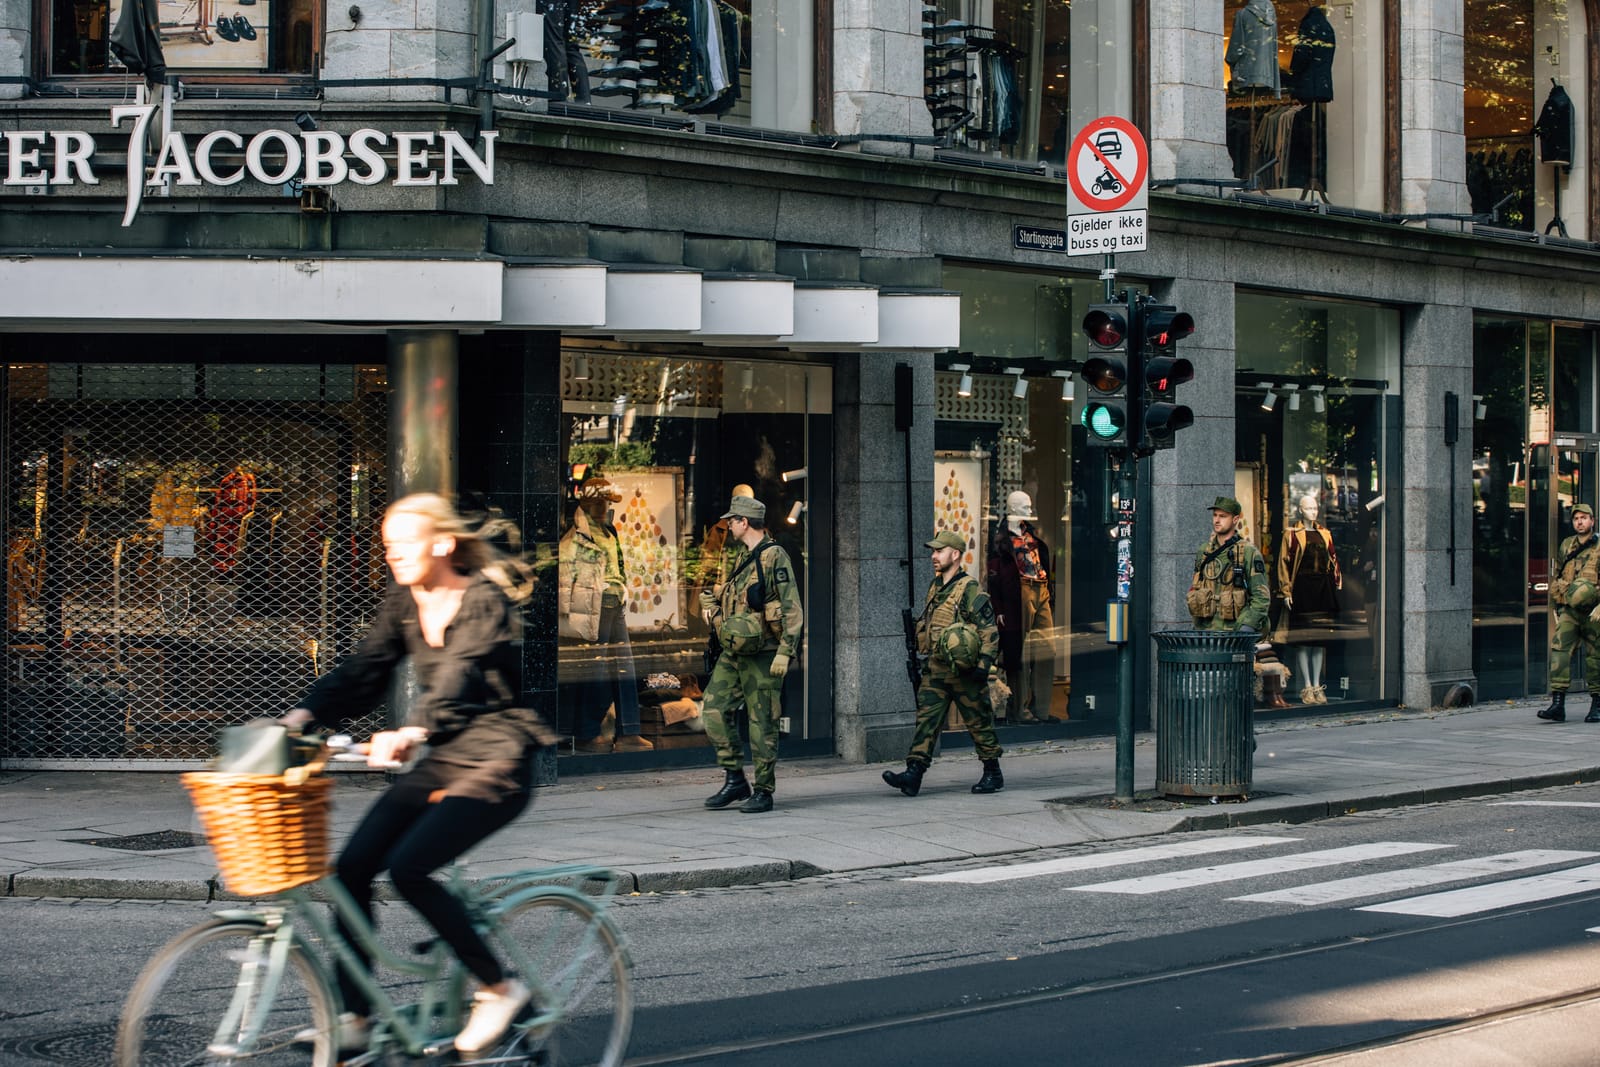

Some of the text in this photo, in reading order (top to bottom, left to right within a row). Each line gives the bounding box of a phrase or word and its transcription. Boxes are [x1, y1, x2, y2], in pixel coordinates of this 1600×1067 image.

[0, 104, 499, 227] ER JACOBSEN
[1071, 216, 1143, 235] Gjelder ikke
[1019, 230, 1064, 249] Stortingsgata
[1071, 233, 1143, 250] buss og taxi
